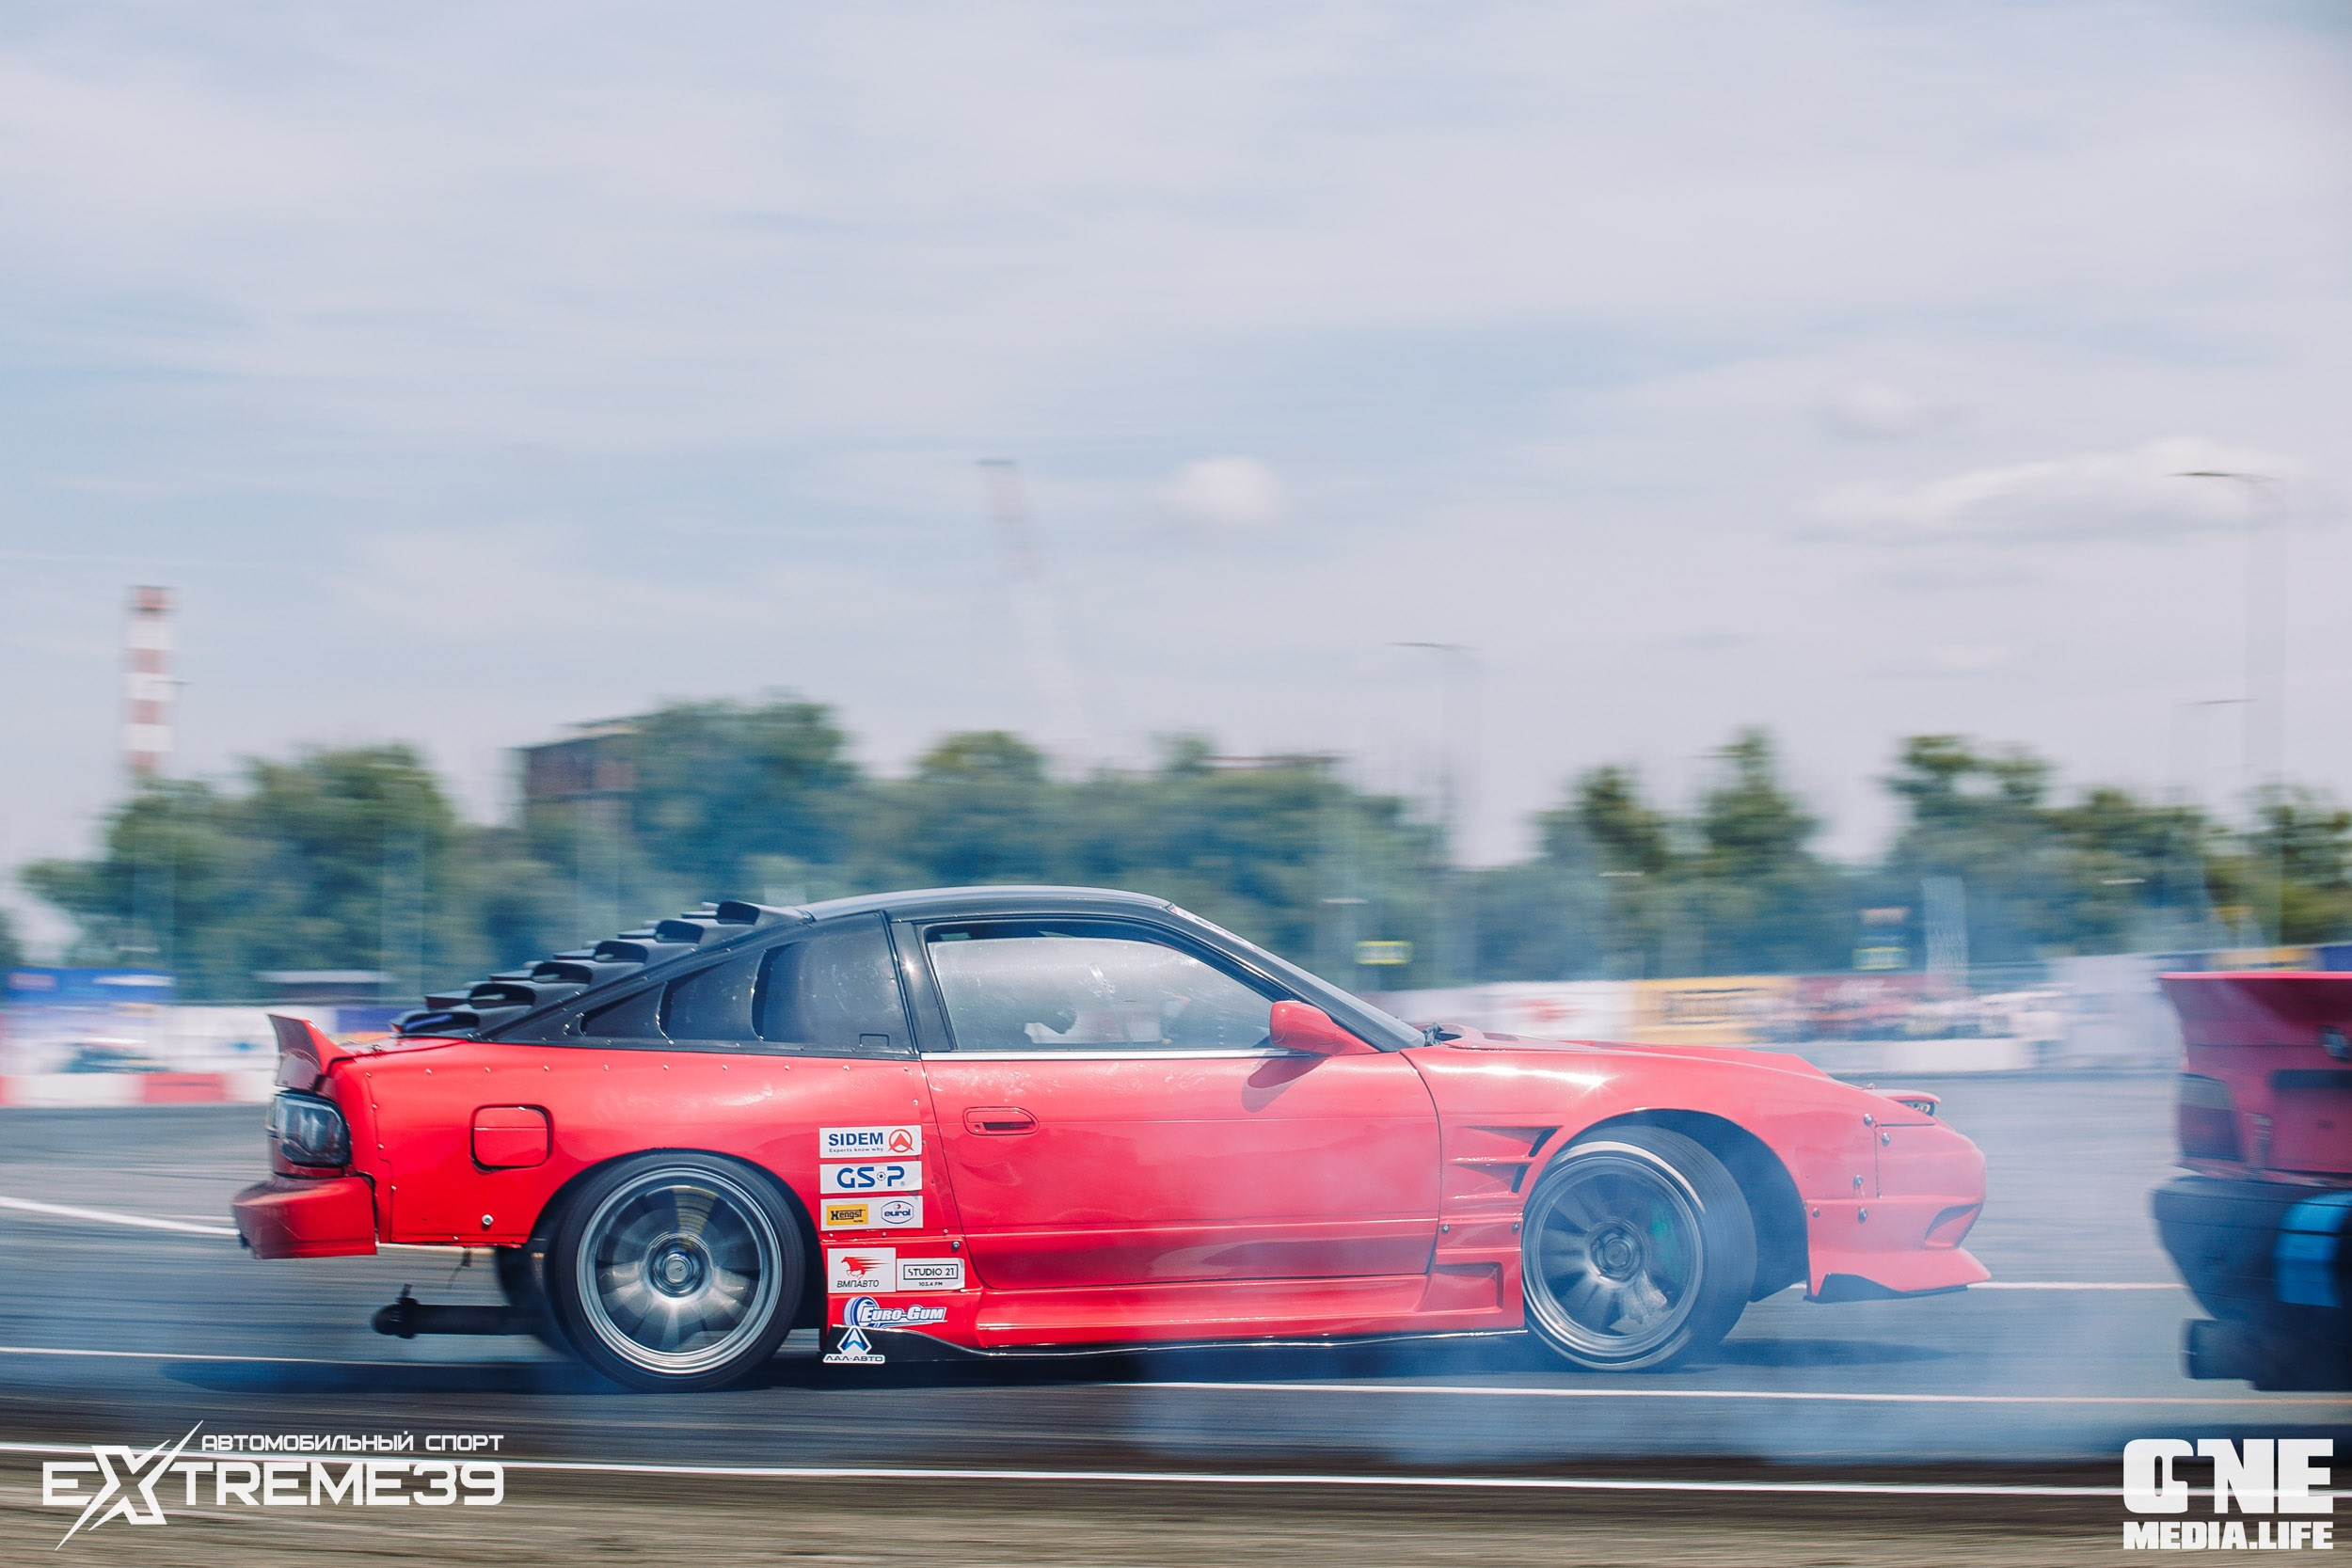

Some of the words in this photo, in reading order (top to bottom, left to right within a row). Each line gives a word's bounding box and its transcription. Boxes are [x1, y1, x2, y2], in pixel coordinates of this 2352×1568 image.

[828, 1132, 883, 1147] SIDEM
[830, 1209, 863, 1221] Hengst
[883, 1208, 912, 1218] eurol
[908, 1267, 944, 1276] STUDIO
[945, 1266, 955, 1276] 21
[836, 1279, 880, 1289] ВМПАВТО
